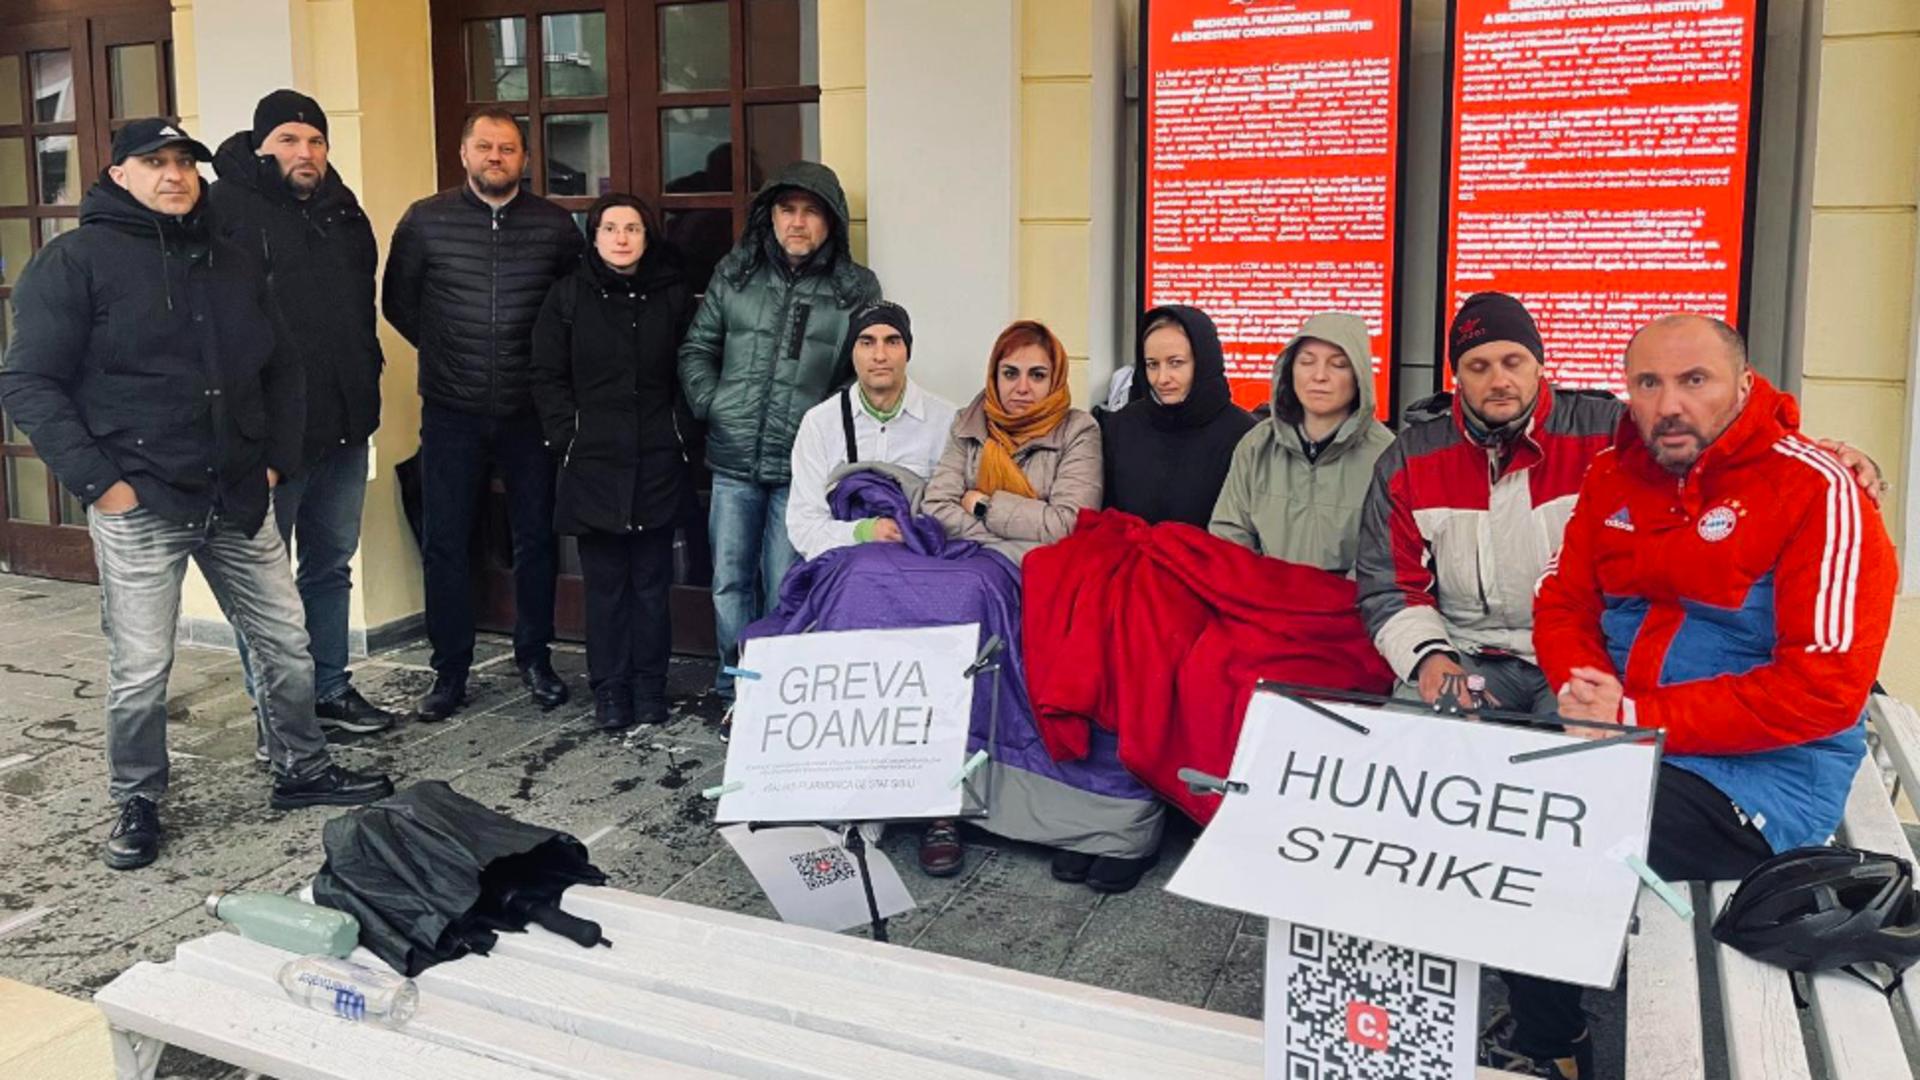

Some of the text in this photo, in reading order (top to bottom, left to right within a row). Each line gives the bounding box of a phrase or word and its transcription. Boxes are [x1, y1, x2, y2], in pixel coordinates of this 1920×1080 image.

[779, 660, 928, 705] GREVA
[1278, 751, 1587, 847] HUNGER
[1278, 827, 1543, 907] STRIKE
